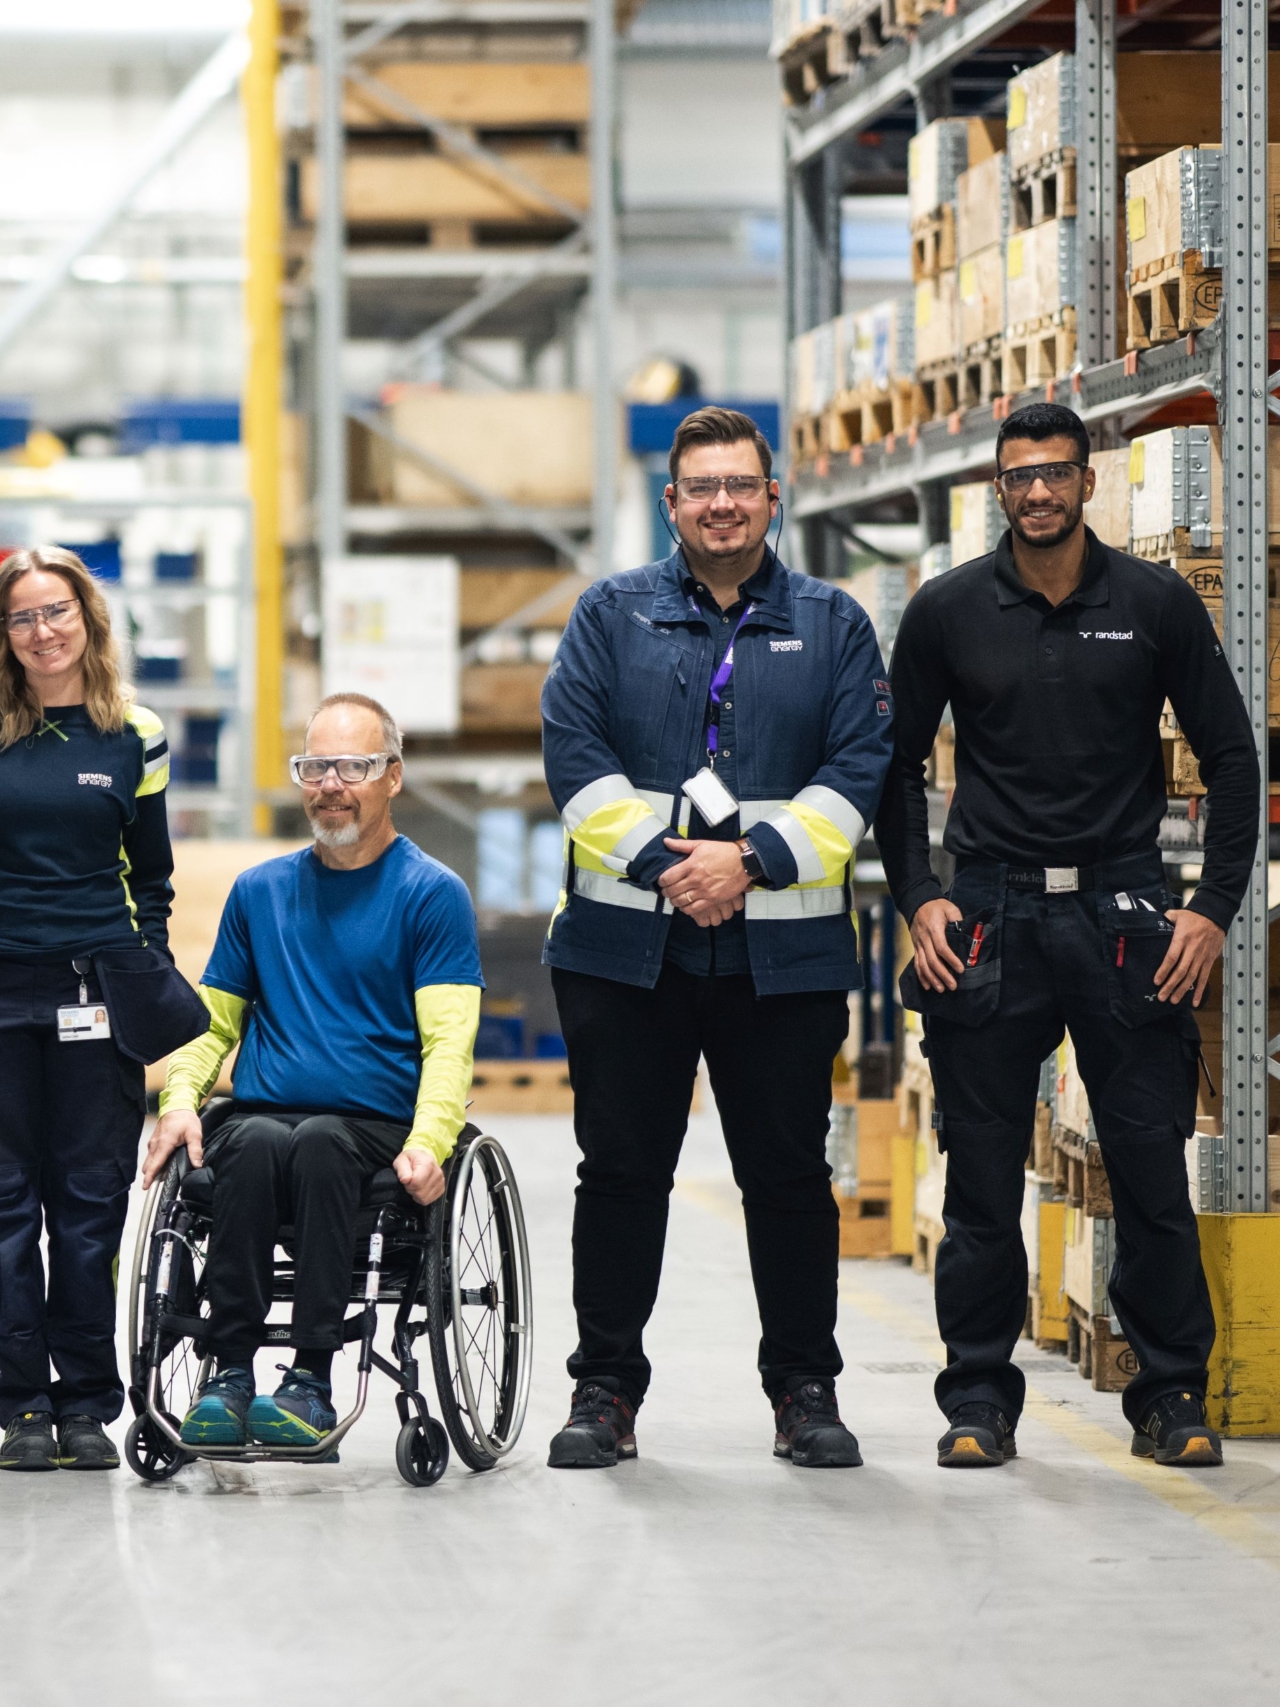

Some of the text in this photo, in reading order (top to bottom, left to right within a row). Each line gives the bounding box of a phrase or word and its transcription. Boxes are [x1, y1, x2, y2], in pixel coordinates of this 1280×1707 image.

[1204, 286, 1223, 305] EP
[1194, 573, 1223, 591] EPA
[1095, 630, 1133, 640] randstad
[769, 640, 803, 648] SIEMENS
[78, 774, 112, 783] SIEMENS
